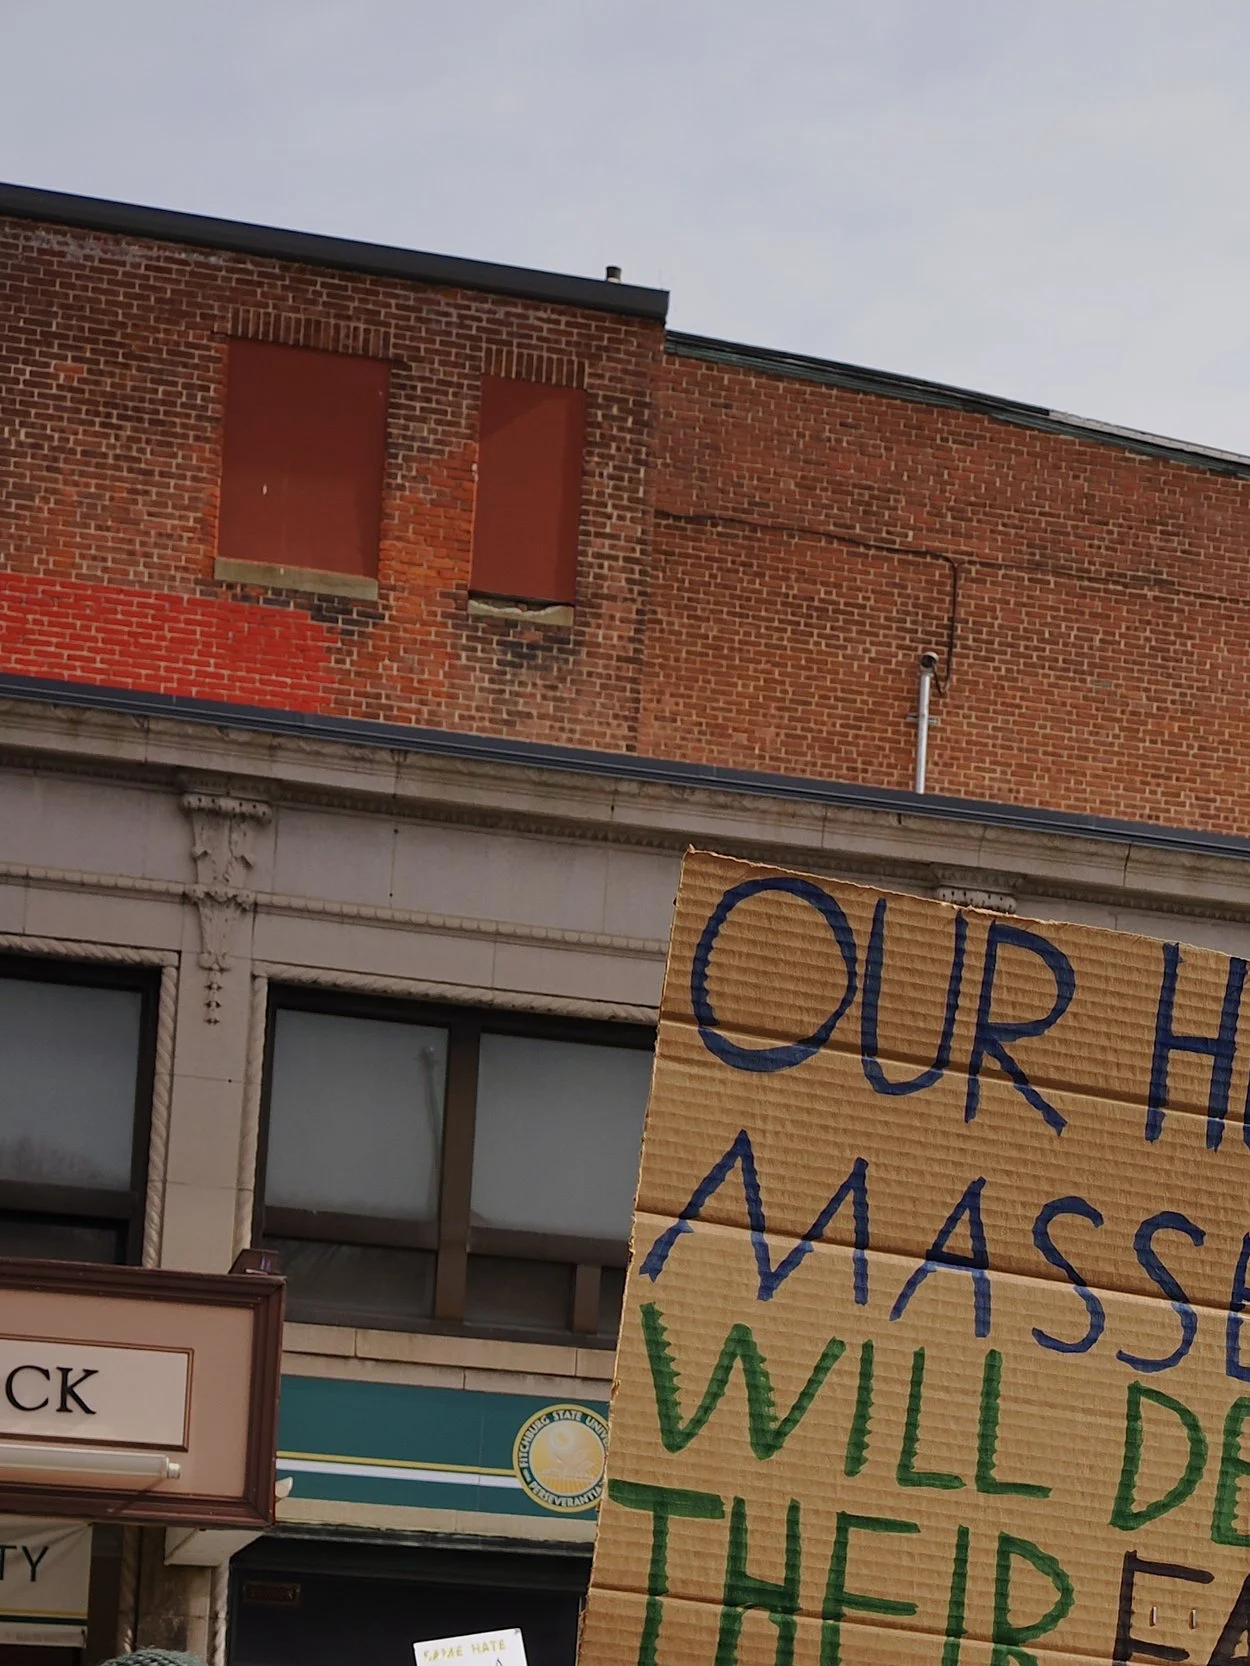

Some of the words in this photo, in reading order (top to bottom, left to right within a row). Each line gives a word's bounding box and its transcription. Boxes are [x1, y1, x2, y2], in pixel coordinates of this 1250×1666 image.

[690, 876, 1076, 1136] OUR
[518, 1415, 550, 1468] FITCHBURG
[552, 1410, 583, 1421] STATE
[639, 1302, 1053, 1498] WILL
[471, 1640, 506, 1655] HATE
